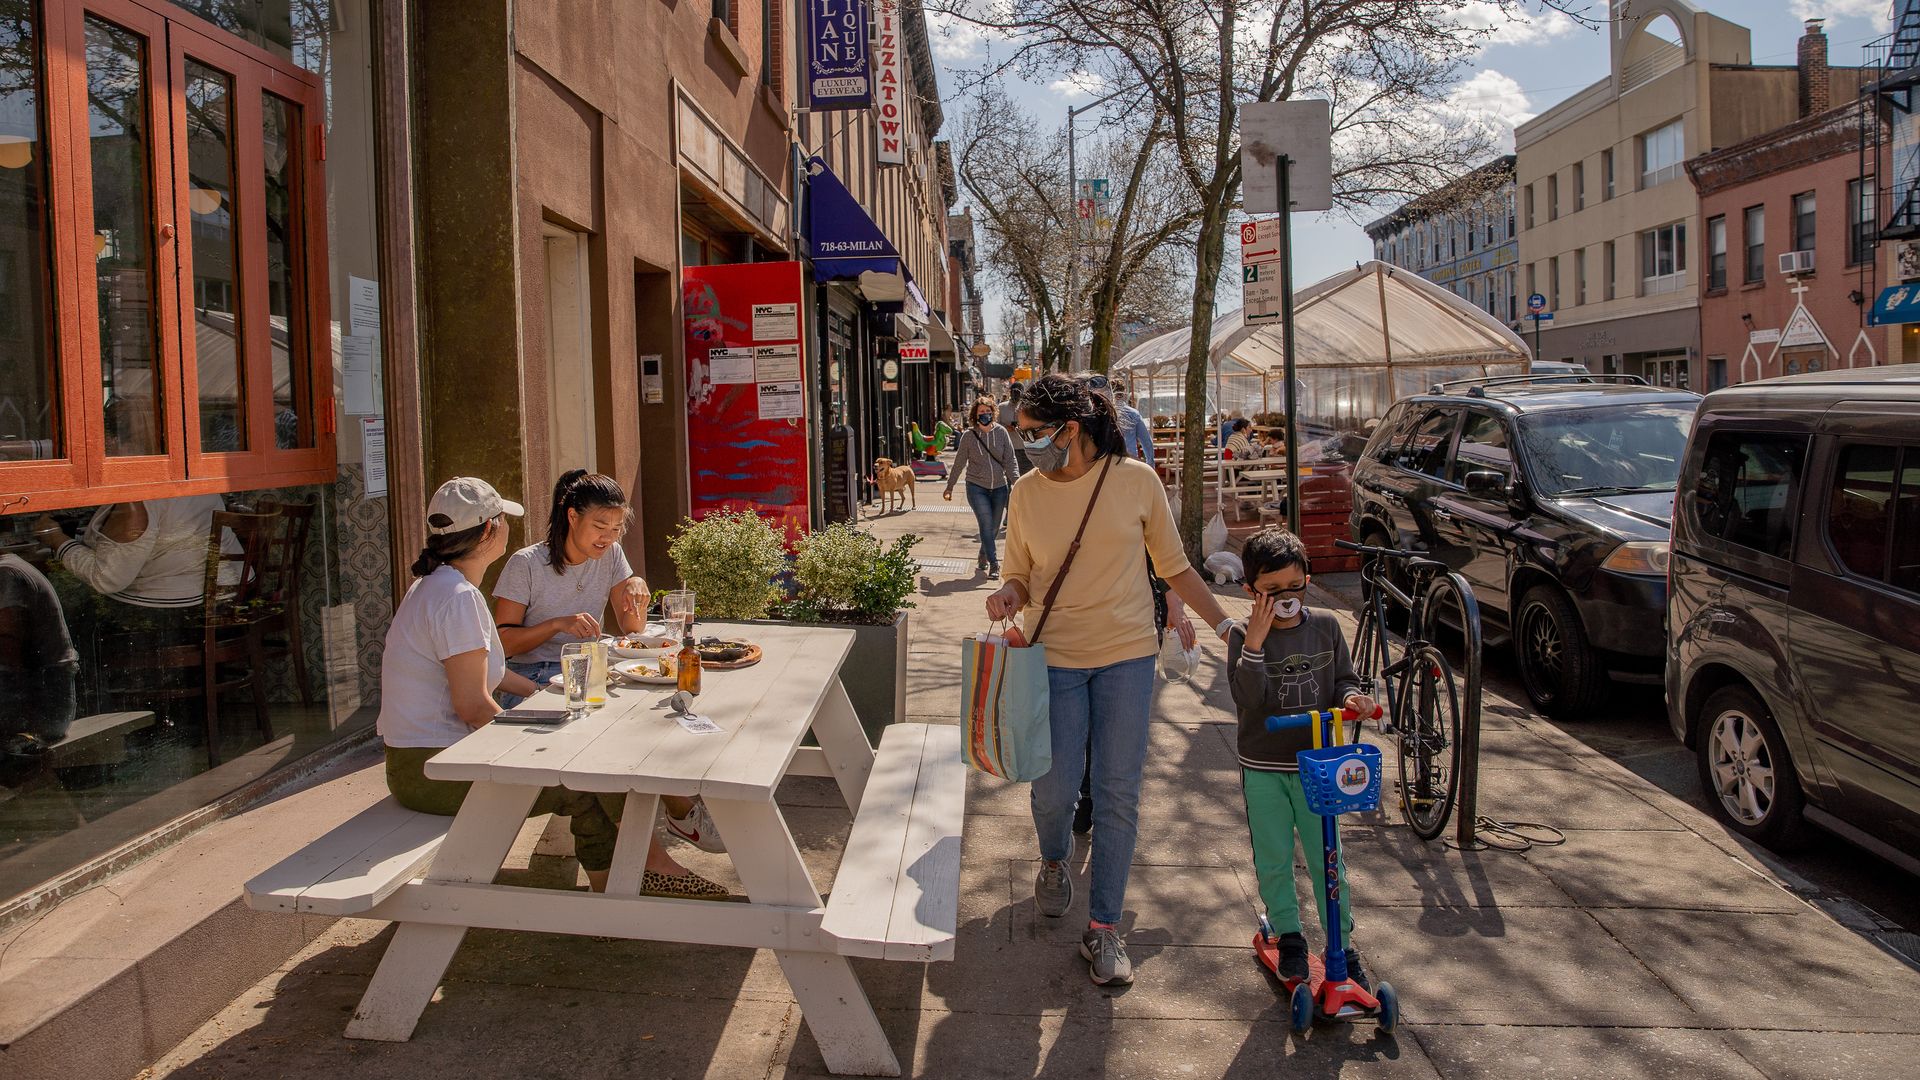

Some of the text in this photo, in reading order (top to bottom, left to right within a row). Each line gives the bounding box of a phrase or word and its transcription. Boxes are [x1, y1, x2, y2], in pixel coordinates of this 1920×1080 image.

[821, 79, 859, 88] LUXURY
[817, 87, 863, 96] EYEWEAR
[820, 241, 883, 251] 718-63-MILAN
[1247, 265, 1254, 281] 2
[1246, 296, 1261, 304] Except
[900, 348, 928, 358] ATM
